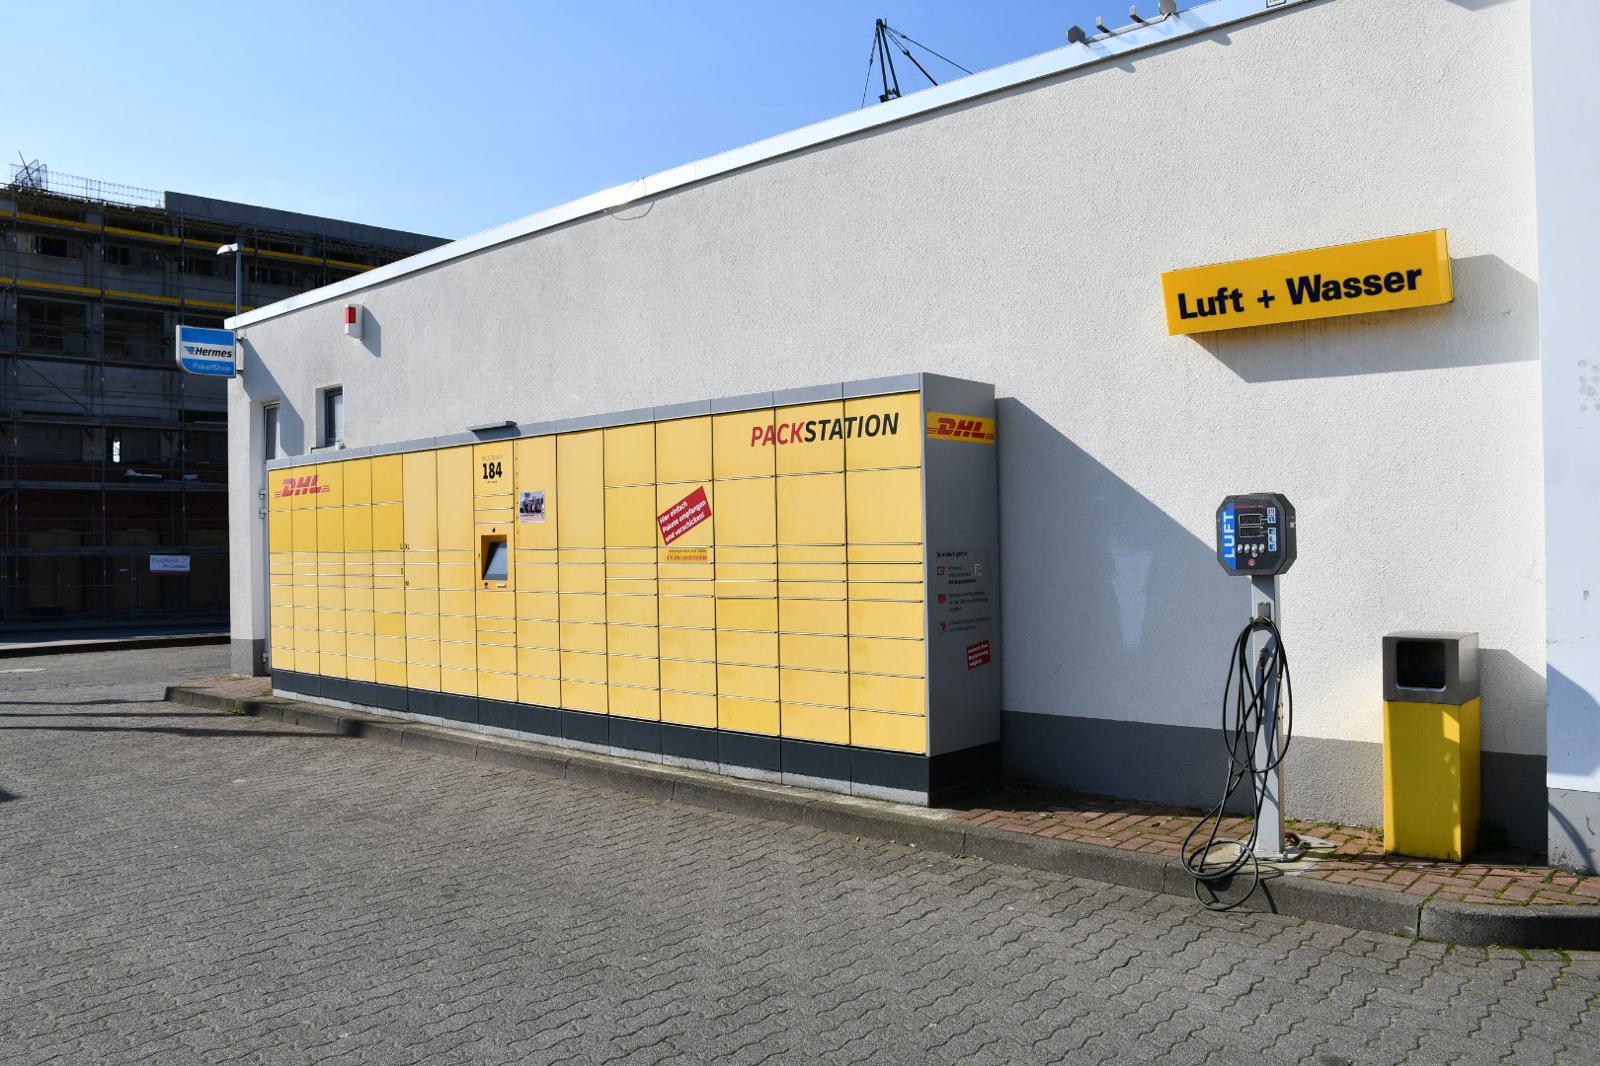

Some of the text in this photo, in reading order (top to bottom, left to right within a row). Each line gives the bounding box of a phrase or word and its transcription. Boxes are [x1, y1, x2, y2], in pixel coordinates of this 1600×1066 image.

[1177, 267, 1422, 320] Luft + Wasser
[195, 346, 232, 358] Hermes
[750, 412, 899, 447] PACKSTATION
[937, 417, 986, 439] DHL
[482, 461, 503, 480] 184
[280, 475, 322, 498] DHL
[1223, 511, 1236, 558] LUFT
